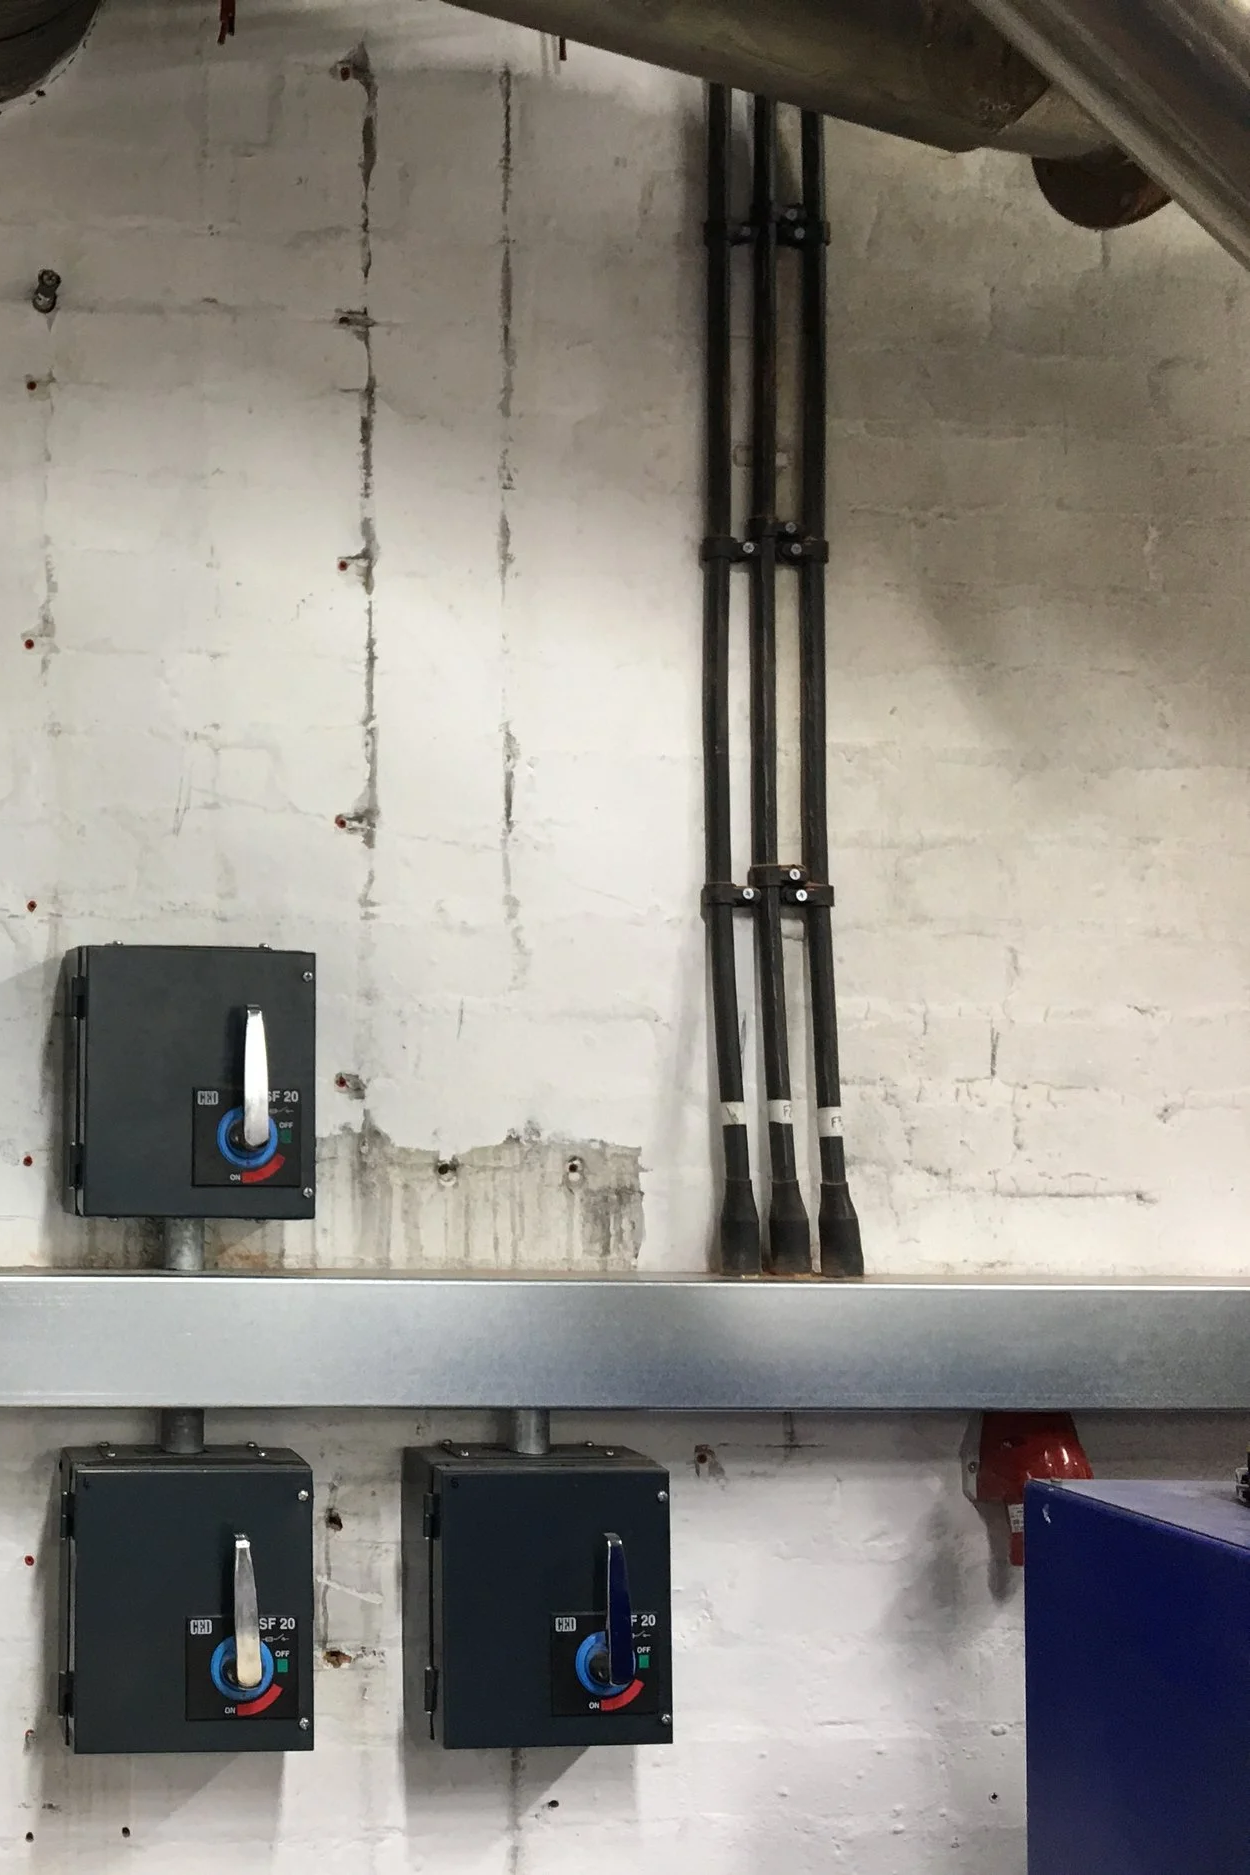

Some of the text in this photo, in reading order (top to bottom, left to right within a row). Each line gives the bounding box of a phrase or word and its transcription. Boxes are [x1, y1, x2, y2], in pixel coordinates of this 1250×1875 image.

[283, 1090, 299, 1102] 20
[229, 1173, 241, 1181] ON
[259, 1617, 296, 1630] SF 20
[555, 1616, 577, 1632] CED
[640, 1614, 656, 1627] 20
[190, 1619, 212, 1635] CED
[274, 1650, 290, 1658] OFF
[636, 1646, 651, 1654] OFF
[224, 1706, 236, 1714] ON
[588, 1701, 600, 1709] ON
